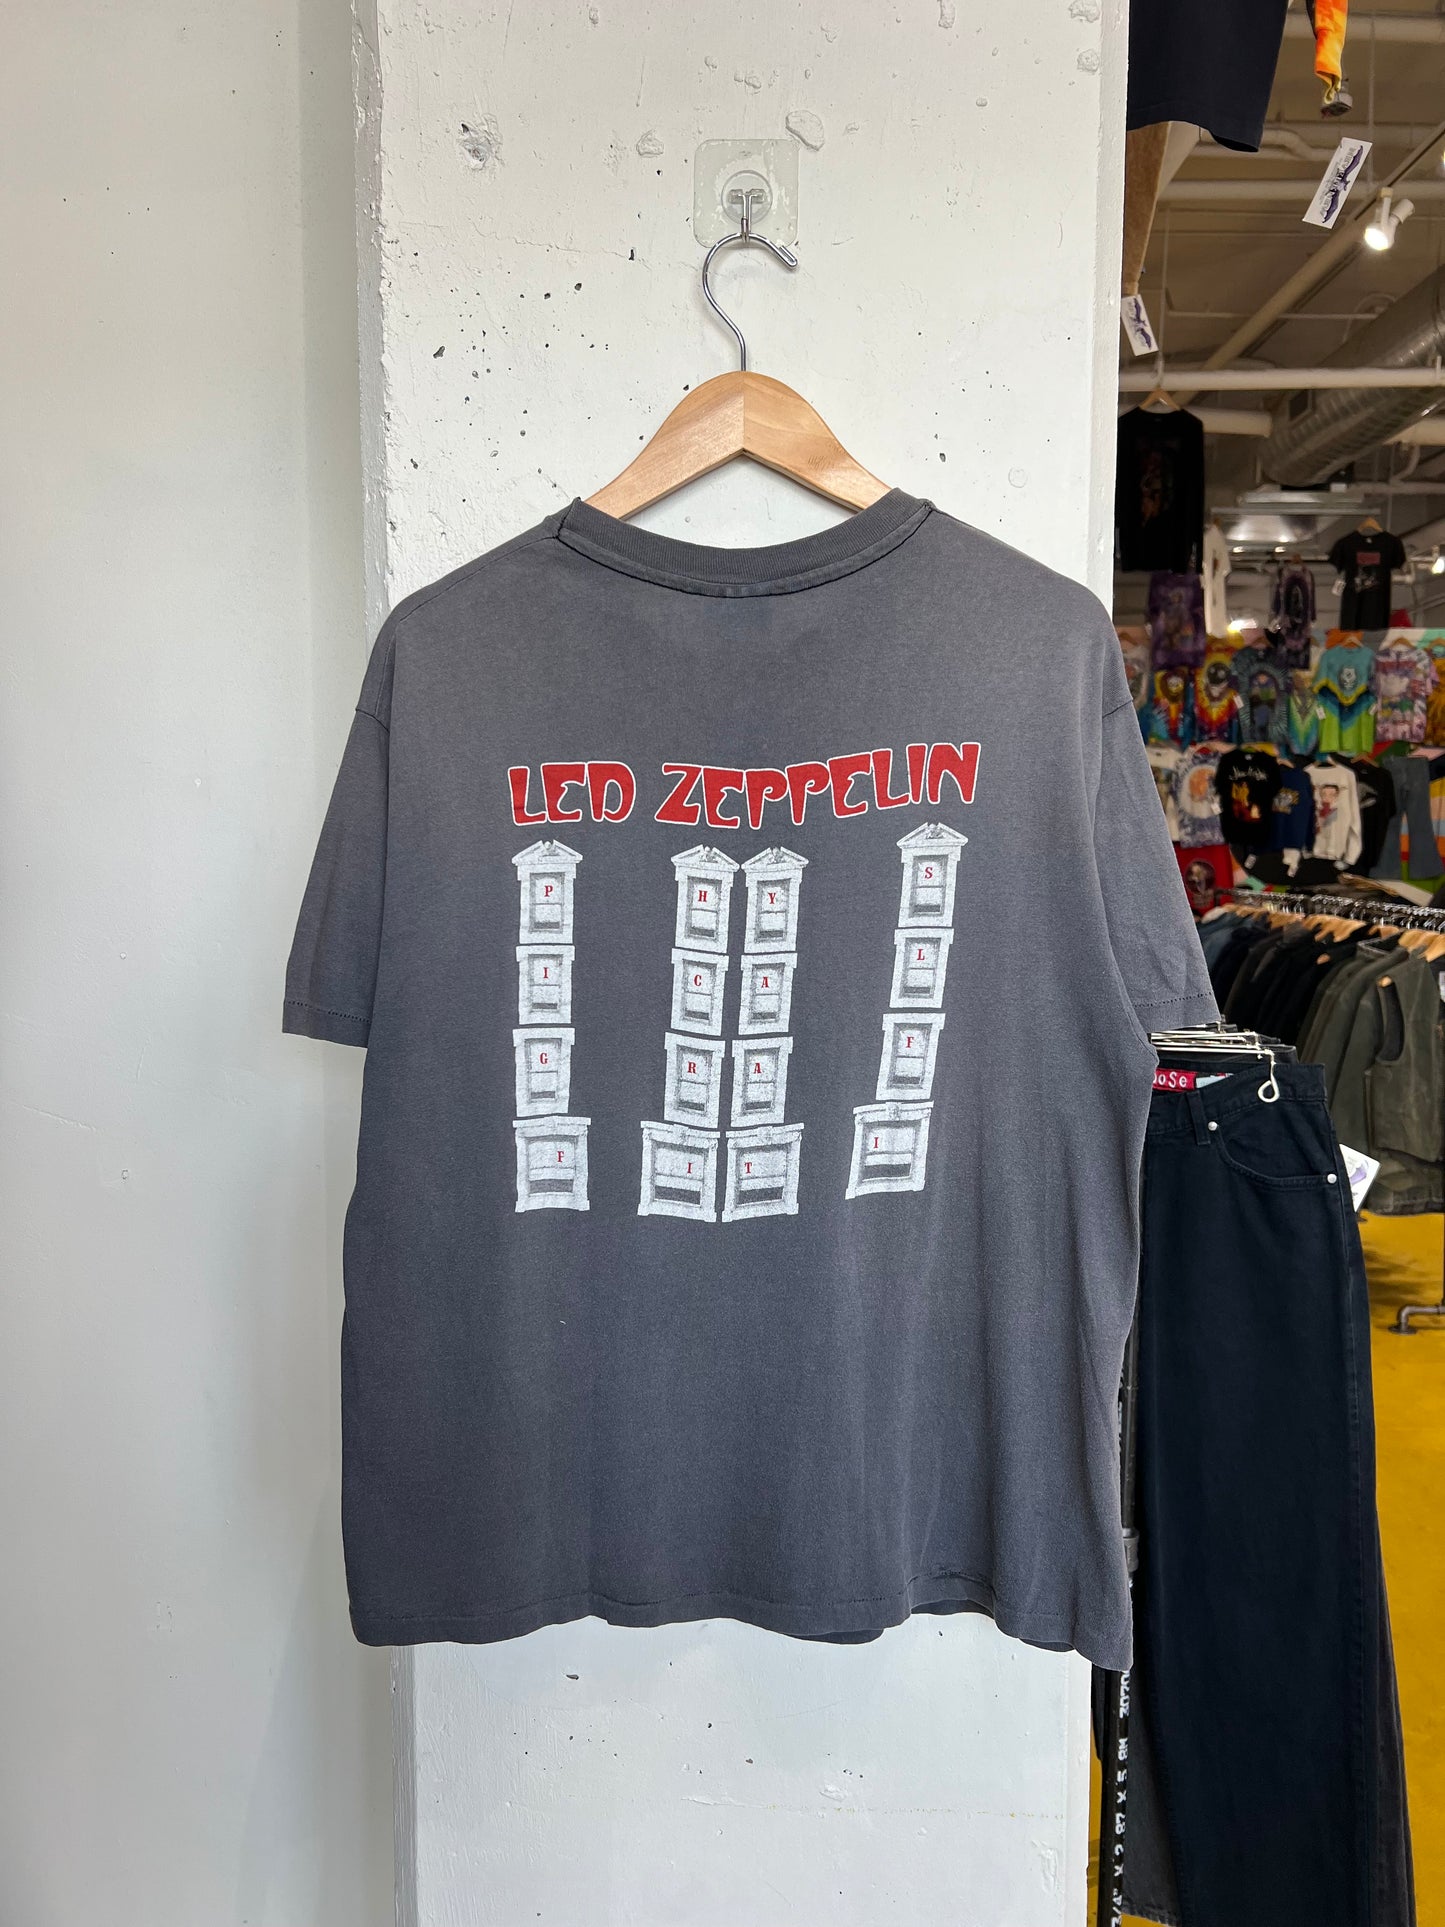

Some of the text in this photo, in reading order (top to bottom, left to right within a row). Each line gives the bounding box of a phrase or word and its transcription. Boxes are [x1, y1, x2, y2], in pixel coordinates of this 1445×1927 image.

[507, 741, 981, 830] LED ZEPPELIN
[543, 866, 934, 905] P H Y S
[542, 947, 926, 989] I C A L
[538, 1035, 915, 1075] G R A F
[556, 1136, 880, 1175] F I T I
[1119, 1670, 1131, 1719] 3070
